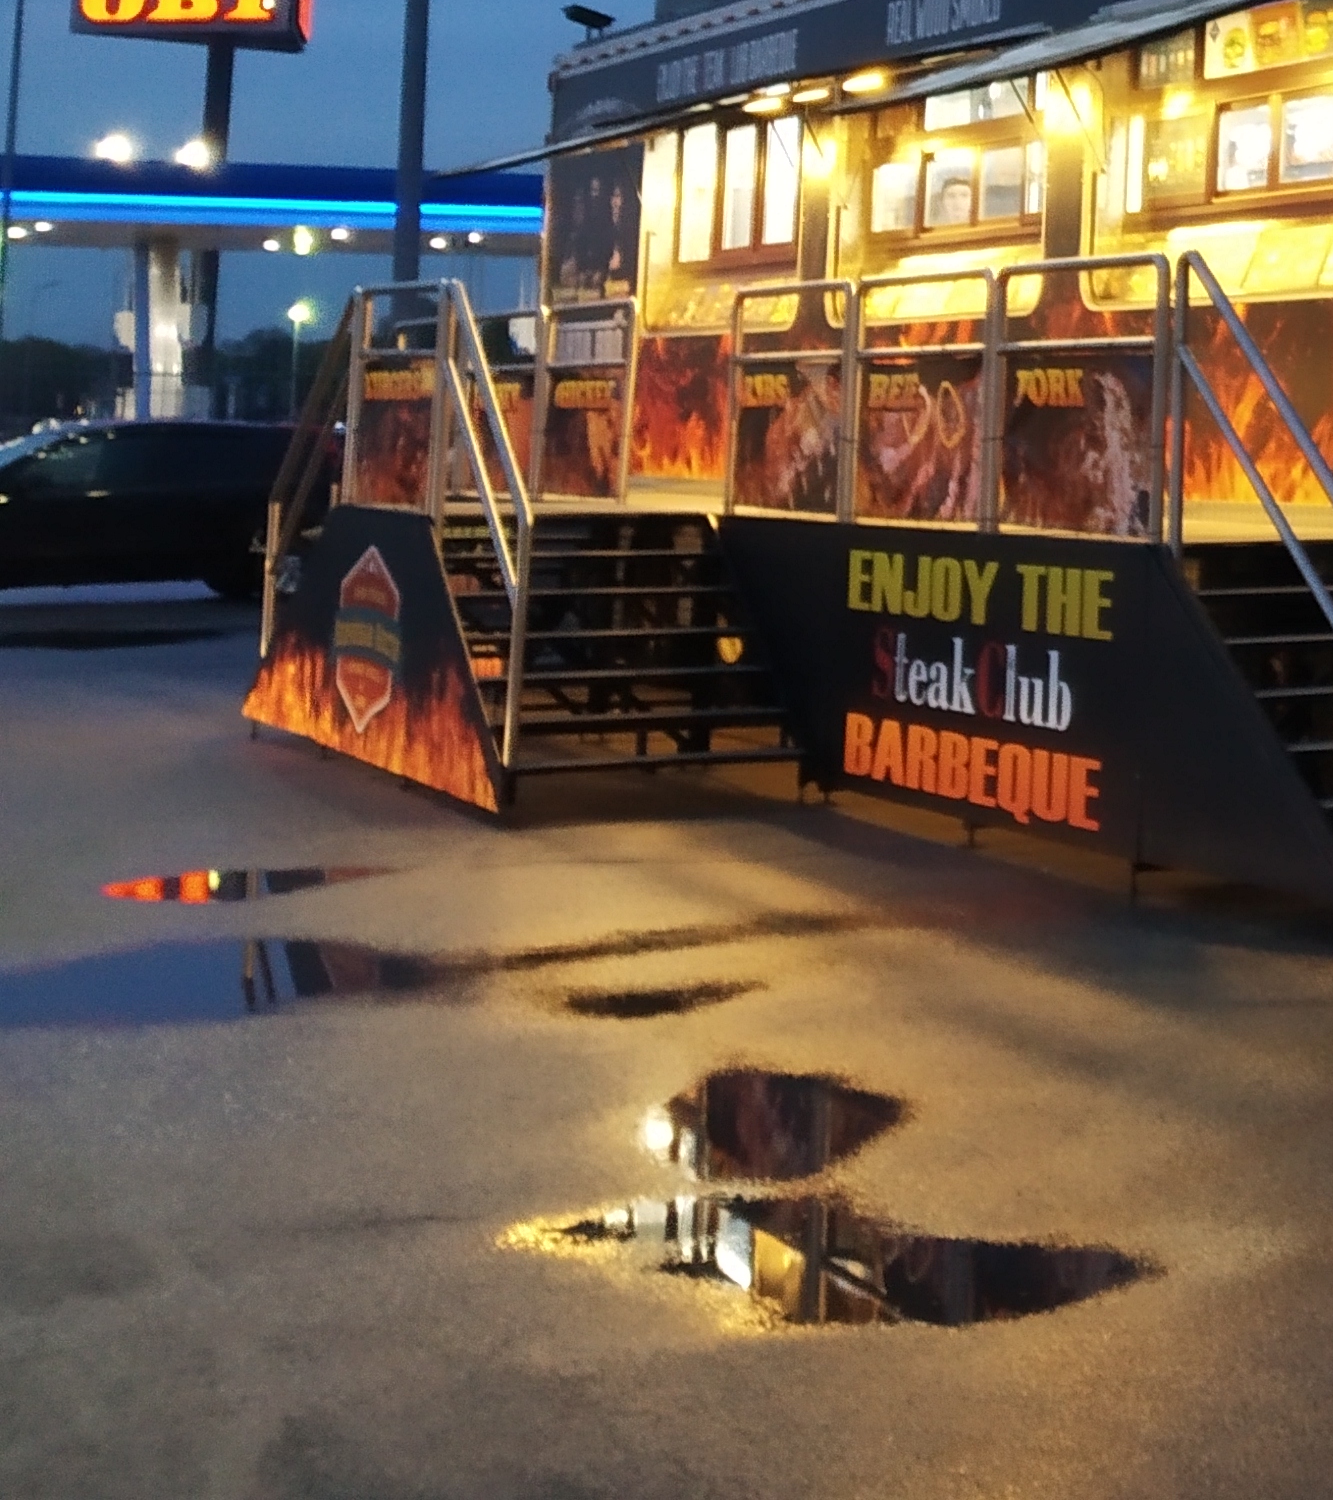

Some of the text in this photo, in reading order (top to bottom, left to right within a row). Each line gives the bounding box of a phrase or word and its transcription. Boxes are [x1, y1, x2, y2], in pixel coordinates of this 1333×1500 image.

[847, 548, 1114, 641] ENJOY THE
[843, 712, 1102, 832] BARBEQUE
